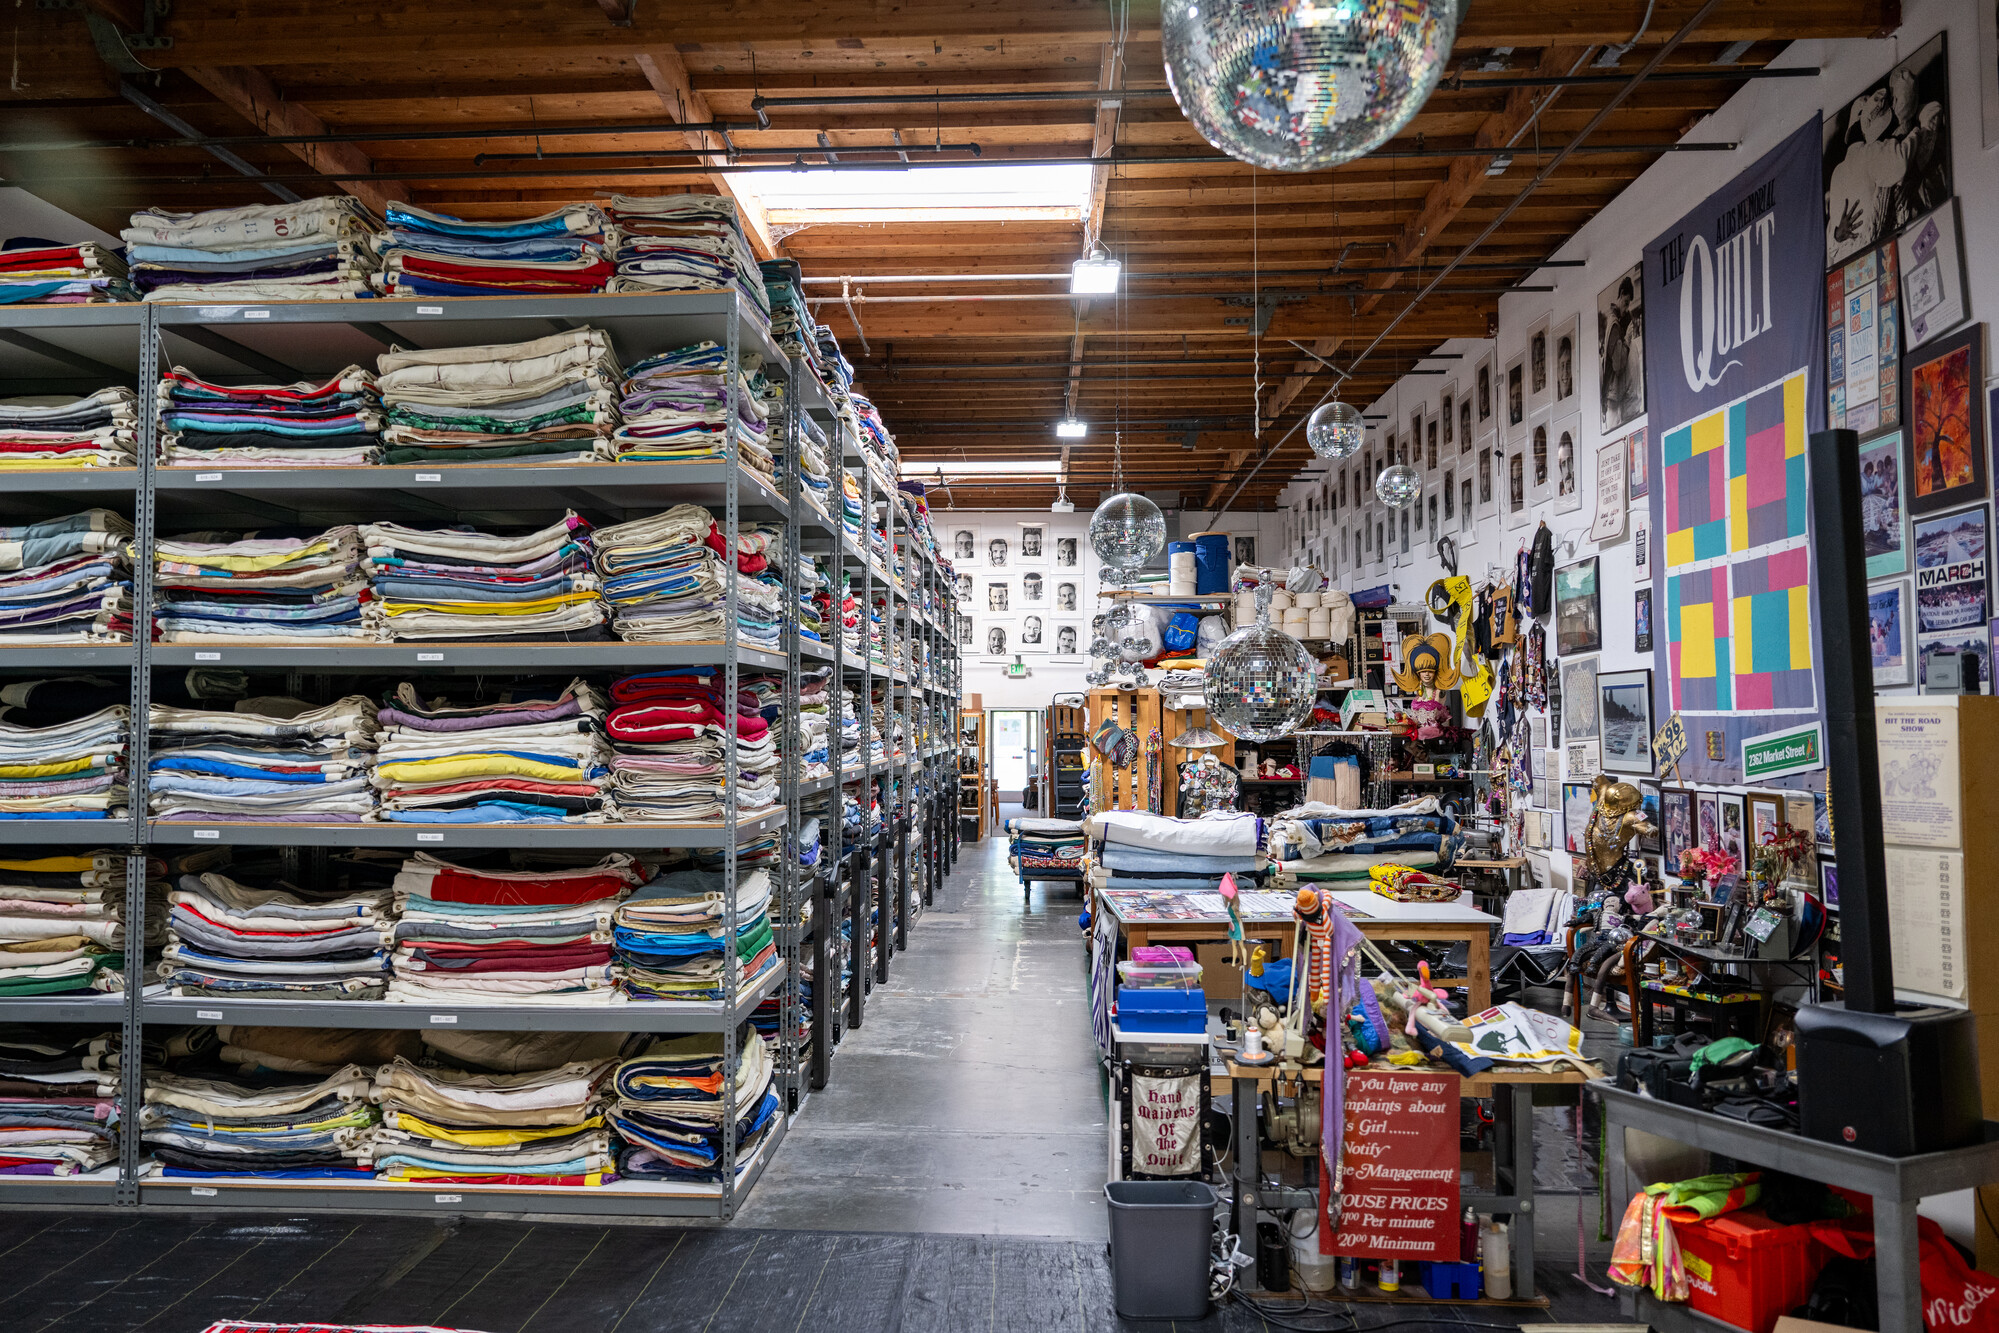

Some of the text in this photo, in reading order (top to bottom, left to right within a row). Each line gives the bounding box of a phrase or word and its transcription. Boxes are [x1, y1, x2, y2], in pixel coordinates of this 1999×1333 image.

[1715, 178, 1776, 245] AIDS MEMORIAL
[1659, 232, 1685, 288] THE
[1679, 211, 1775, 393] QUILT
[1601, 452, 1621, 468] JUST TAKE
[1613, 462, 1621, 472] THE
[1605, 486, 1611, 495] ON
[1603, 493, 1618, 505] GROUND
[1919, 560, 1985, 588] MARCH
[1010, 664, 1024, 675] EXIT
[1481, 681, 1490, 697] 3
[1463, 692, 1472, 708] 2
[1665, 719, 1680, 742] 96
[1901, 725, 1924, 733] SHOW
[1667, 731, 1687, 761] 102
[1748, 744, 1806, 767] 2362 Market Street
[1360, 1078, 1384, 1094] you
[1388, 1077, 1418, 1094] have
[1421, 1082, 1447, 1095] any
[1148, 1088, 1182, 1104] Hand
[1137, 1105, 1195, 1120] Maidens
[1344, 1098, 1446, 1115] mplaints about
[1158, 1122, 1175, 1137] Of
[1156, 1137, 1177, 1152] The
[1344, 1141, 1391, 1158] Notify
[1341, 1163, 1454, 1182] he Management
[1389, 1196, 1448, 1211] PRICES
[1362, 1213, 1385, 1227] Per
[1388, 1215, 1435, 1229] minute
[1368, 1235, 1435, 1251] Minimum
